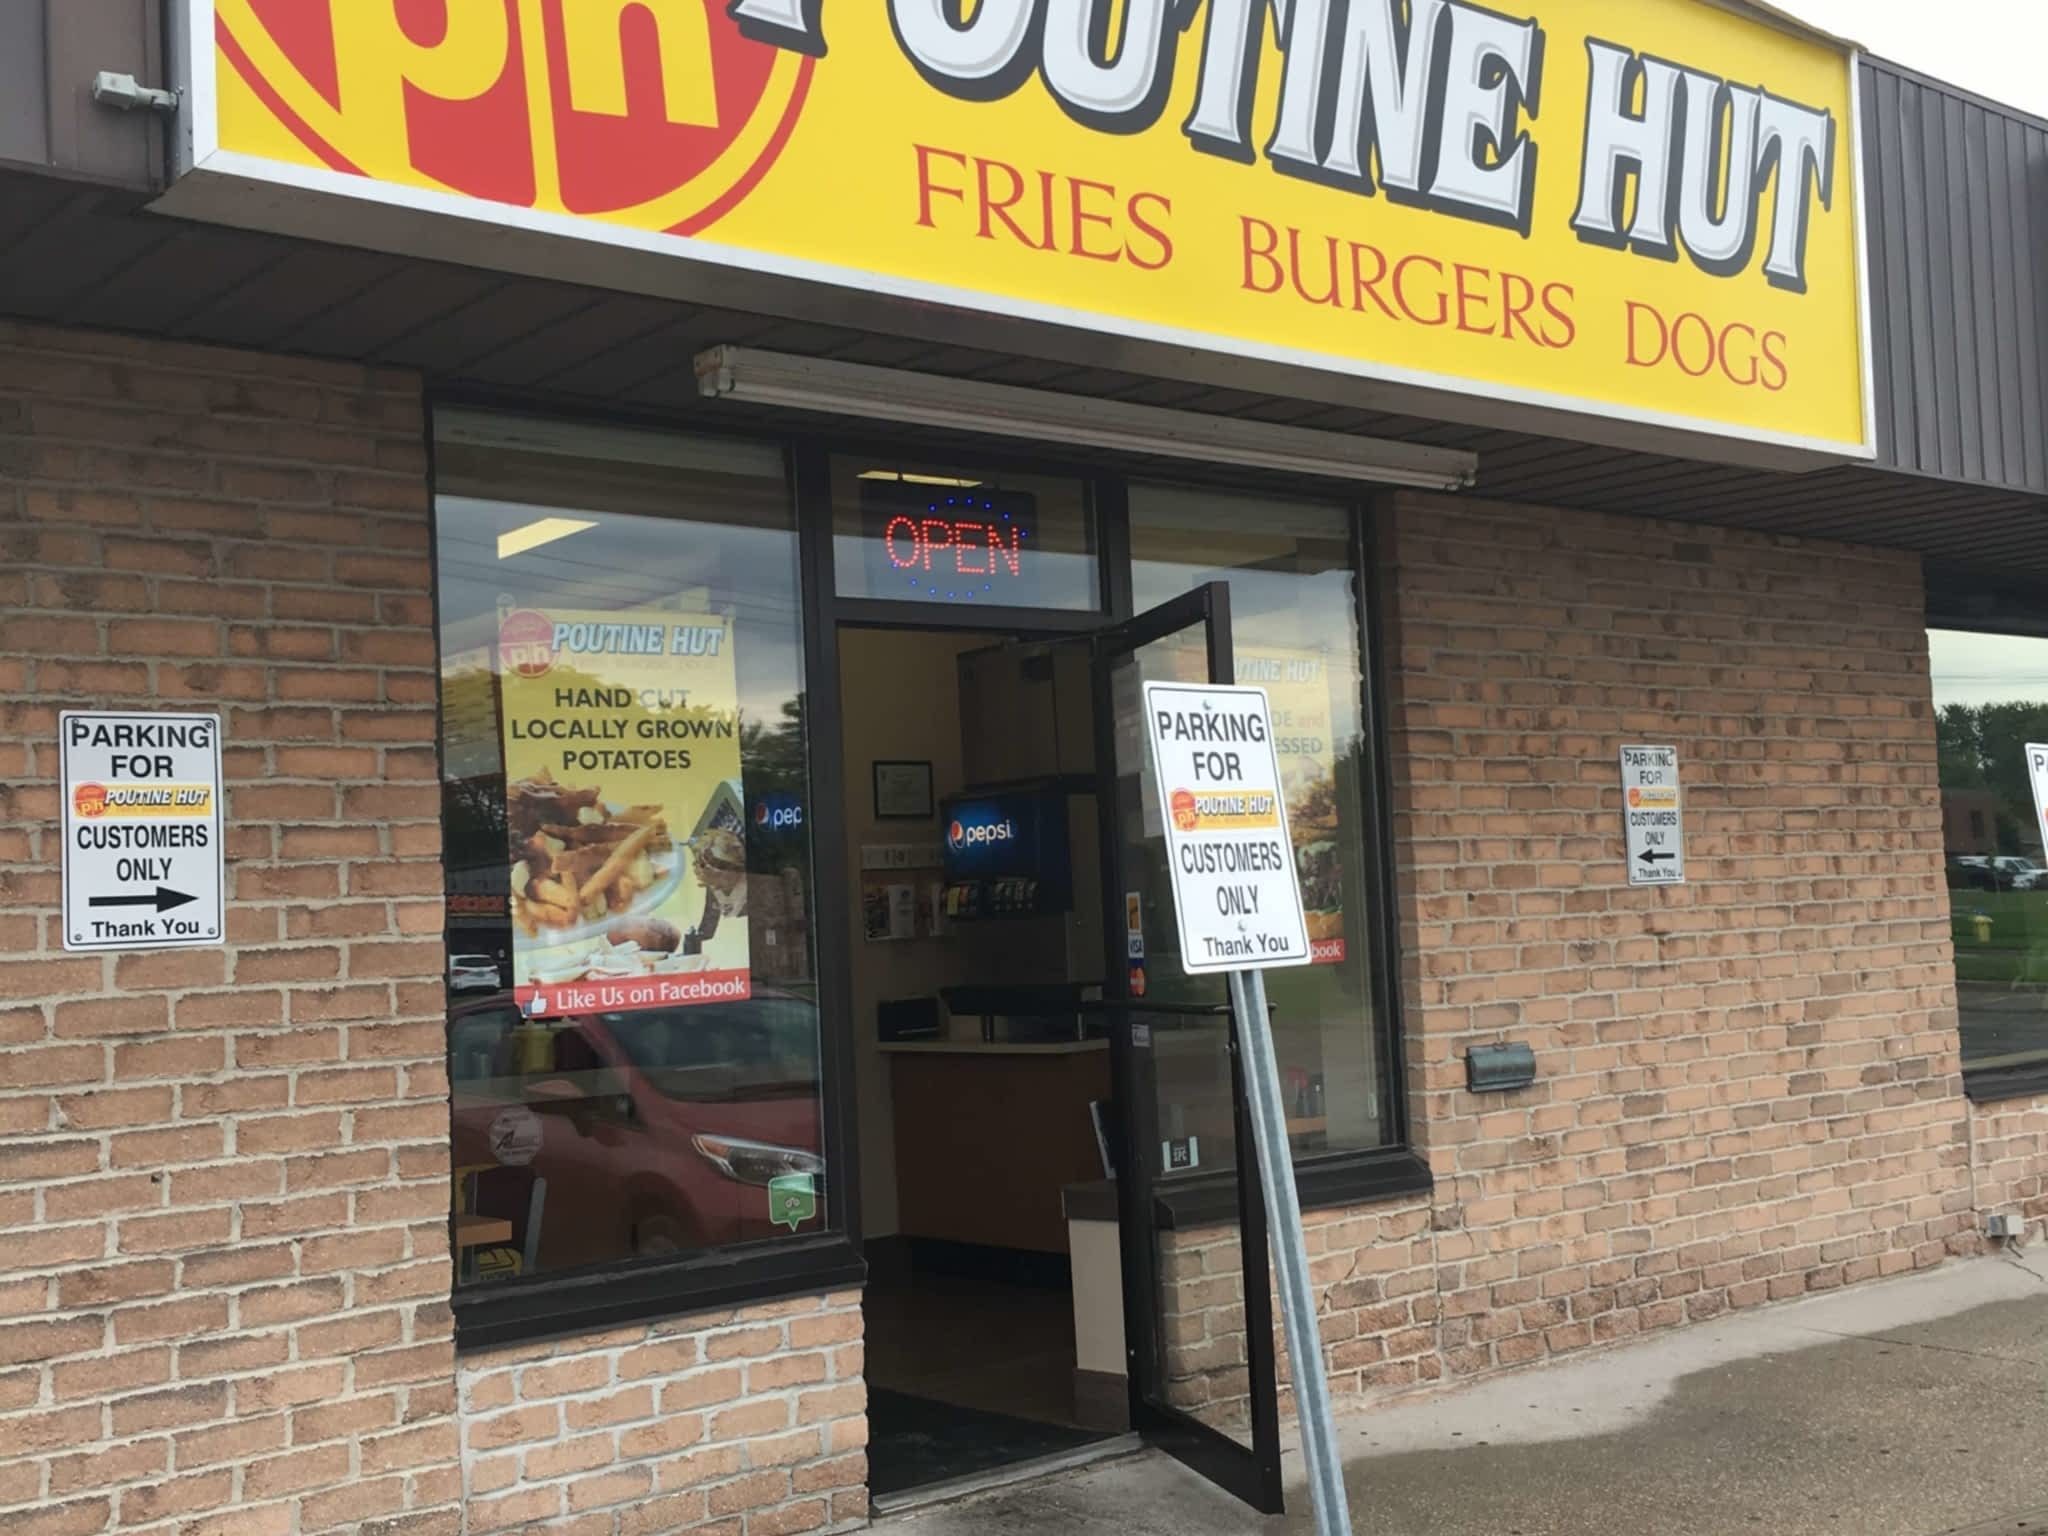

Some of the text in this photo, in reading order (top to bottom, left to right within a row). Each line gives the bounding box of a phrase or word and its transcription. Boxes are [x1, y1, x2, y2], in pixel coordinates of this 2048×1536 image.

[732, 0, 1836, 294] UTINE HUT
[912, 142, 1789, 392] FRIES BURGERS DOGS
[885, 515, 1020, 576] OPEN
[552, 622, 725, 657] POUTINE HUT
[554, 687, 692, 709] HAND CUT
[72, 725, 210, 748] PARKING
[511, 719, 733, 739] LOCALLY GROWN
[1157, 711, 1266, 743] PARKING
[112, 755, 174, 778] FOR
[563, 750, 692, 770] POTATOES
[1192, 752, 1242, 781] FOR
[1624, 752, 1674, 767] PARKING
[1639, 770, 1663, 785] FOR
[104, 788, 210, 806] POUTINE HUT
[1194, 795, 1274, 816] POUTINE HUT
[1630, 811, 1678, 827] CUSTOMERS
[77, 824, 209, 850] CUSTOMERS
[965, 819, 1011, 846] pepsi
[1644, 831, 1666, 846] ONLY
[116, 857, 173, 882] ONLY
[1181, 841, 1283, 875] CUSTOMERS
[1637, 867, 1677, 879] Thank You
[1216, 885, 1260, 917] ONLY
[91, 919, 199, 938] Thank You
[1202, 933, 1289, 957] Thank You
[557, 976, 745, 1010] Like Us on Facebook
